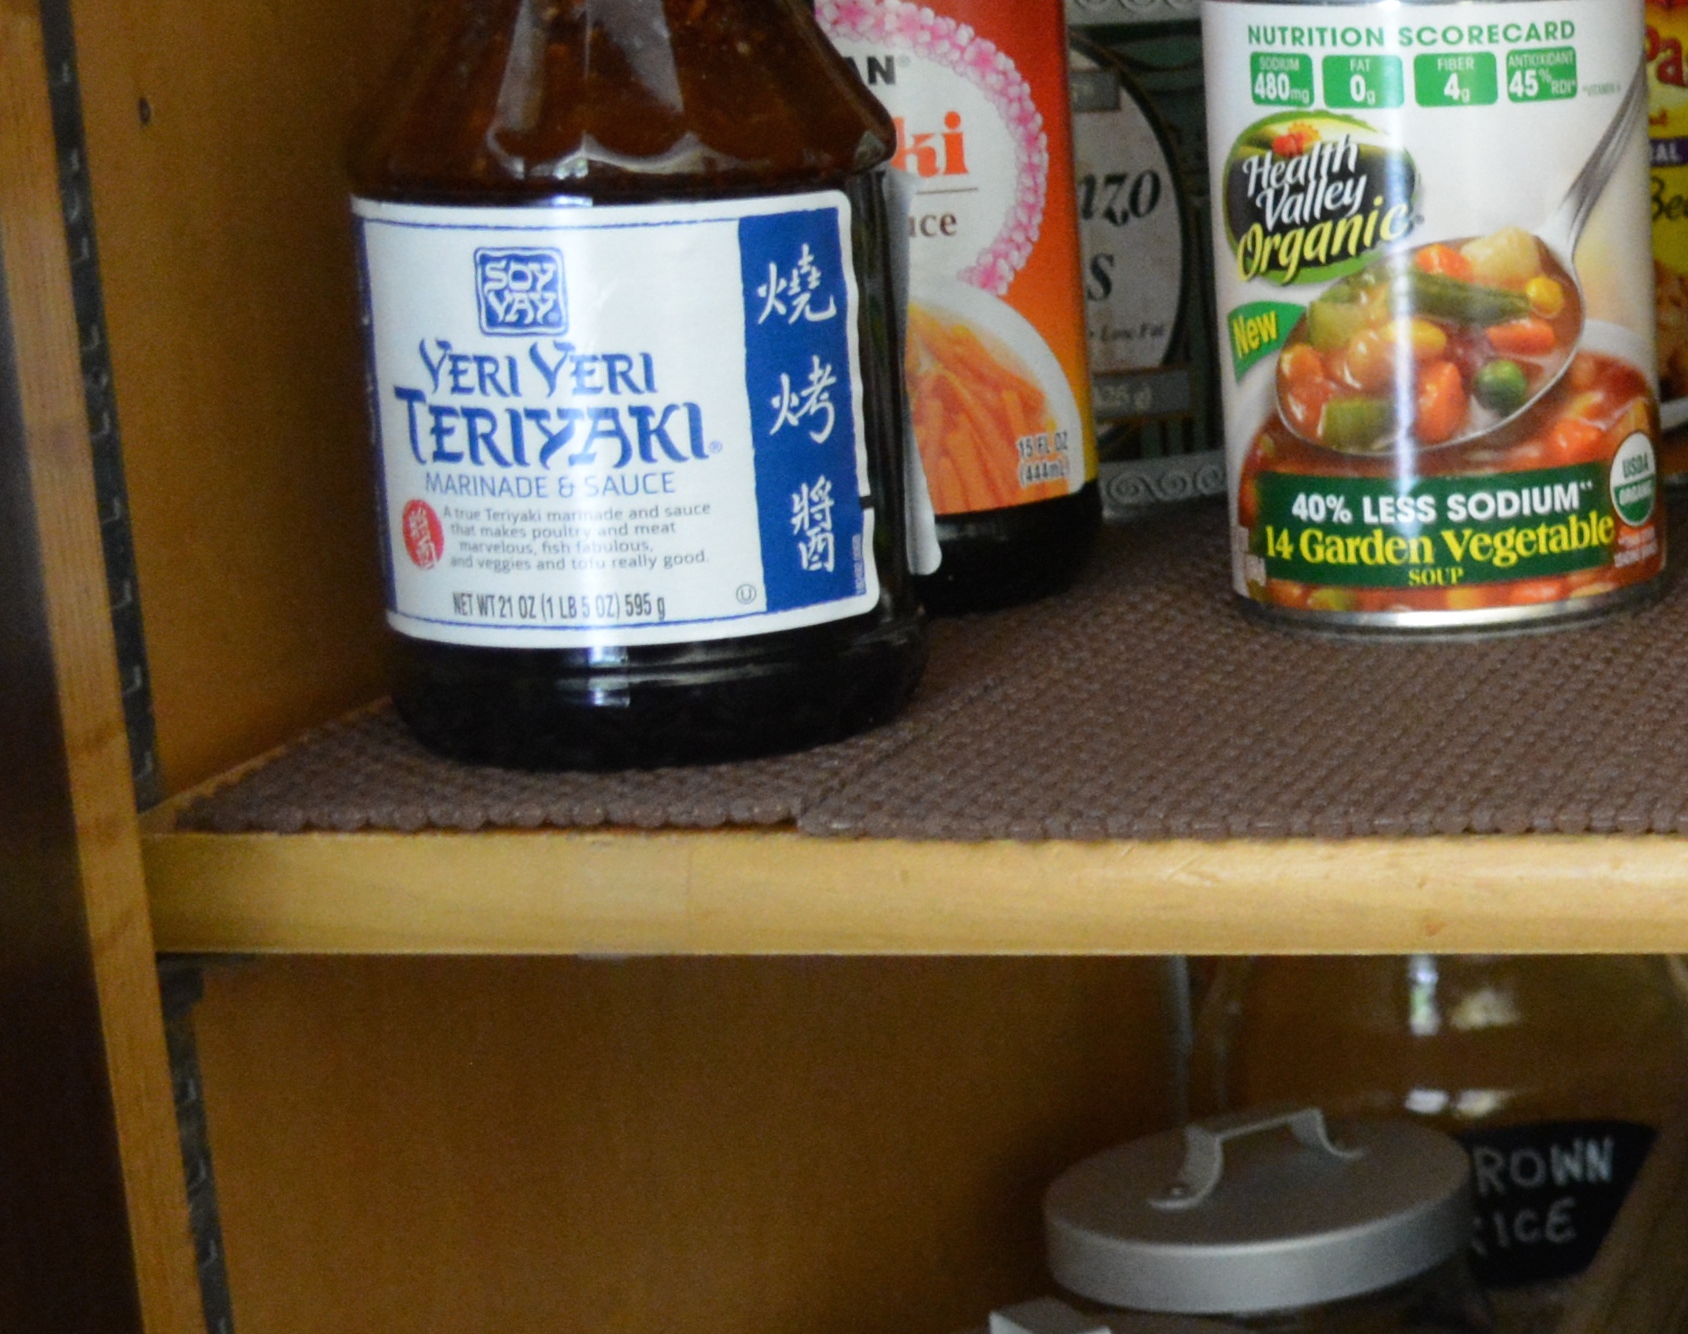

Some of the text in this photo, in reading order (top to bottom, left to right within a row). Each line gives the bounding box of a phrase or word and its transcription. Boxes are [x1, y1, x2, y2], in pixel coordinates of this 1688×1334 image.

[1248, 20, 1575, 48] NUTRITION SCORECARD
[1259, 51, 1574, 72] SODIUM FAT FIBER ANTIOXIDANT
[1242, 133, 1359, 196] Health
[1256, 175, 1367, 233] Valley
[1237, 193, 1412, 282] Organic
[485, 258, 556, 290] SOY
[486, 290, 556, 326] VAY
[1232, 311, 1278, 358] New
[394, 386, 710, 470] TERIYAKI
[425, 471, 676, 498] MARINADE & SAUCE
[455, 503, 711, 525] true Teriyaki marinade and sauce
[1291, 493, 1352, 525] 40%
[1362, 493, 1437, 525] LESS
[451, 521, 676, 541] that makes poultry meat
[460, 538, 653, 556] marvelous, fish fabulous,
[1265, 525, 1294, 561] 14
[1300, 525, 1436, 567] Garden
[1441, 510, 1615, 567] Vegetable
[477, 551, 709, 574] veggies and tofu really good.
[1407, 568, 1464, 587] SOUP
[453, 591, 652, 620] NET WT 21 OZ LB 5 OZ) 595
[1473, 1135, 1617, 1197] ROWN
[1471, 1196, 1578, 1259] ICE
